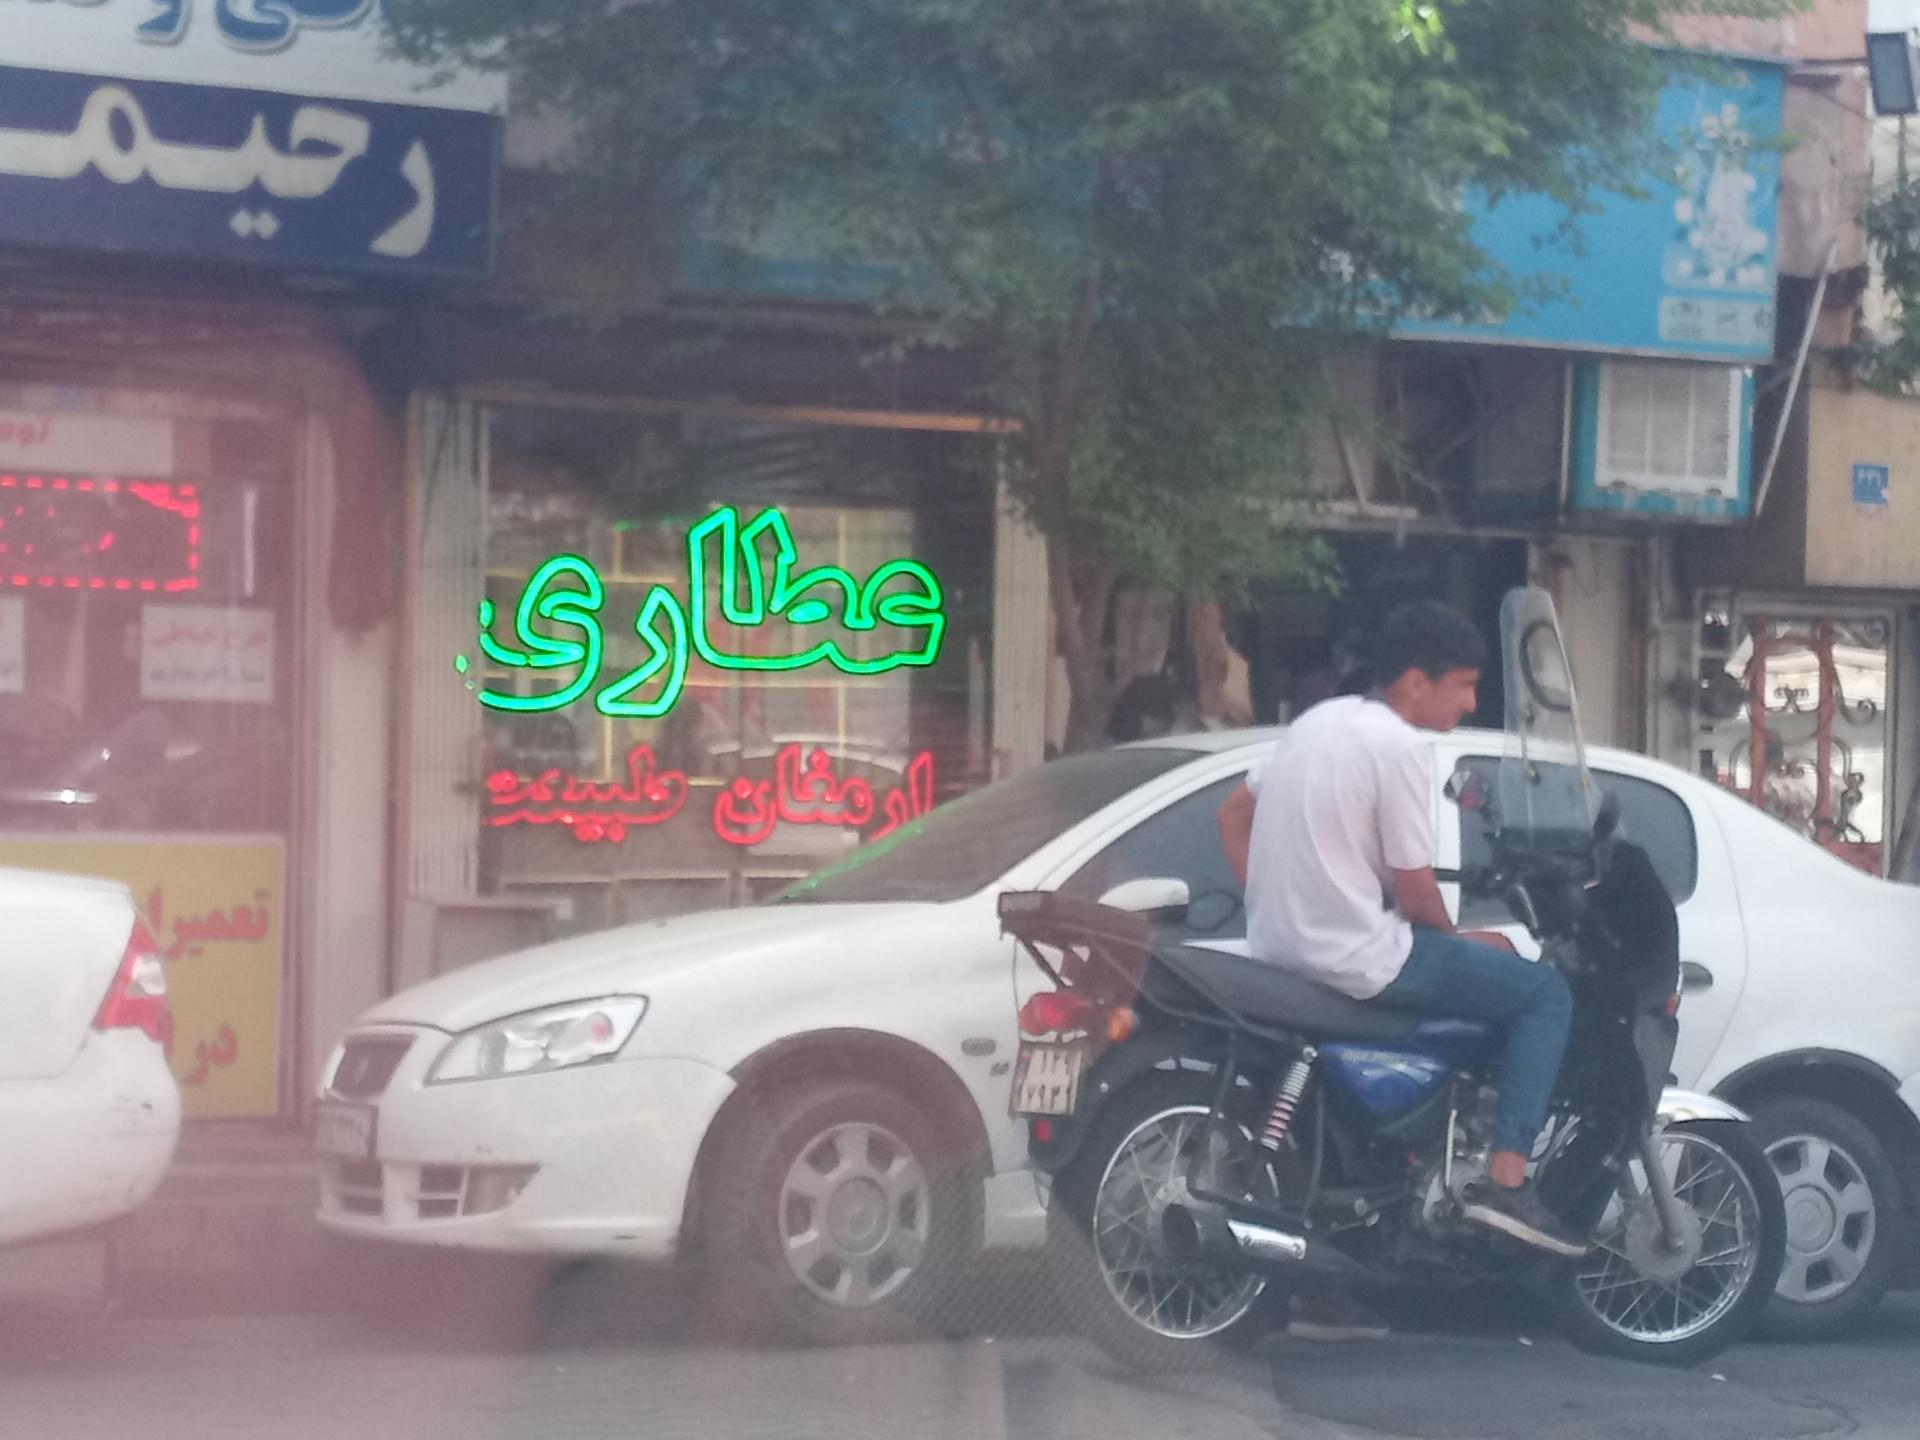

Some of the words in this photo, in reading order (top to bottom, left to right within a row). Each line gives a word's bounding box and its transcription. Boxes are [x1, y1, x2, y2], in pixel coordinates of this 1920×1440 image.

[0, 86, 436, 257] رحیم
[470, 505, 947, 718] عطاری
[482, 743, 690, 843] طبیعت
[712, 743, 934, 845] ارمغان
